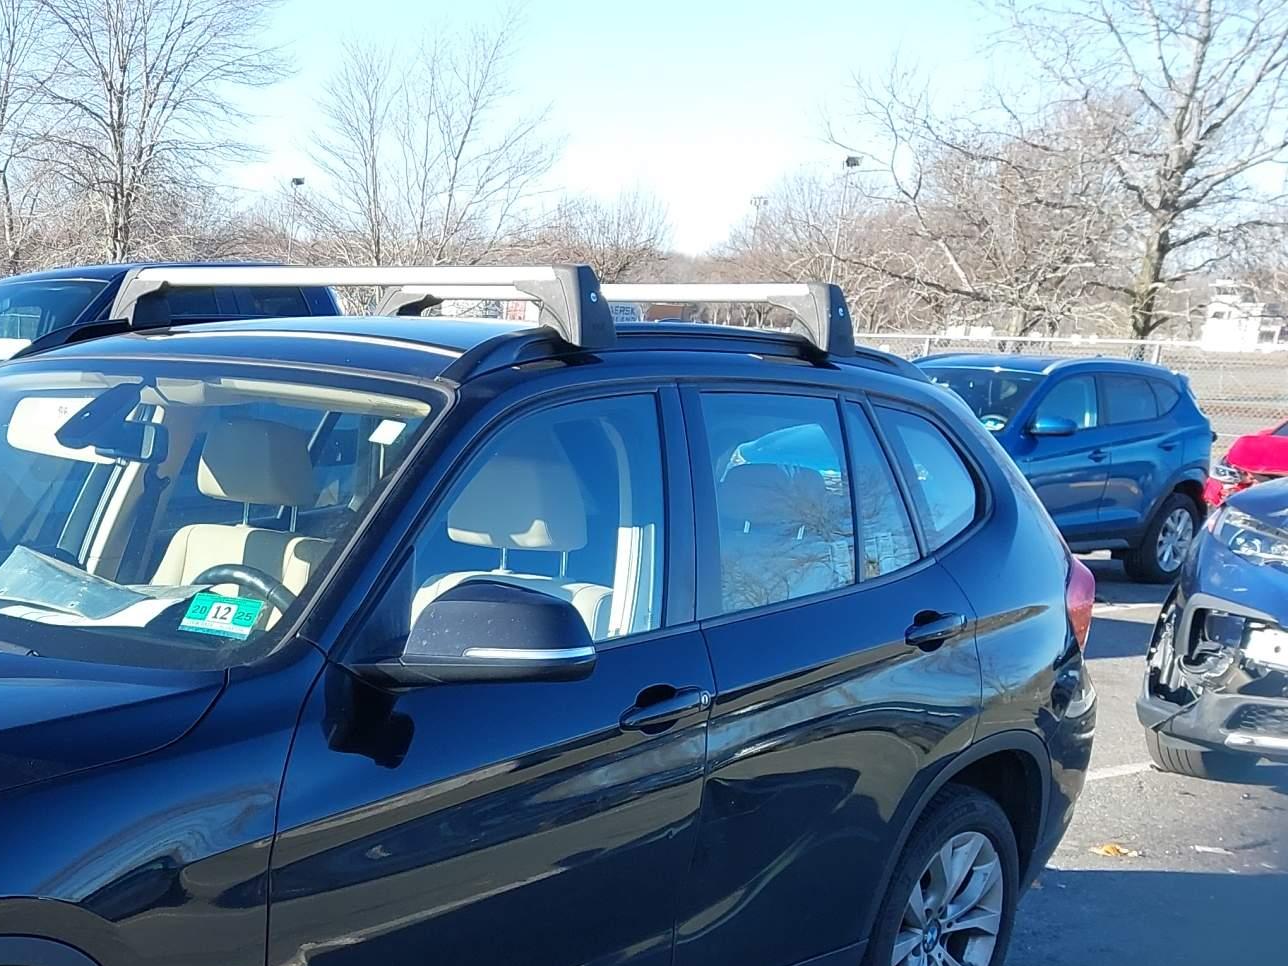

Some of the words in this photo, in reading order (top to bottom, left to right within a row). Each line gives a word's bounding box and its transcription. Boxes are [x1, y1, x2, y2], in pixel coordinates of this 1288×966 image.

[191, 604, 208, 615] 20
[211, 605, 232, 621] 12
[235, 611, 254, 622] 25
